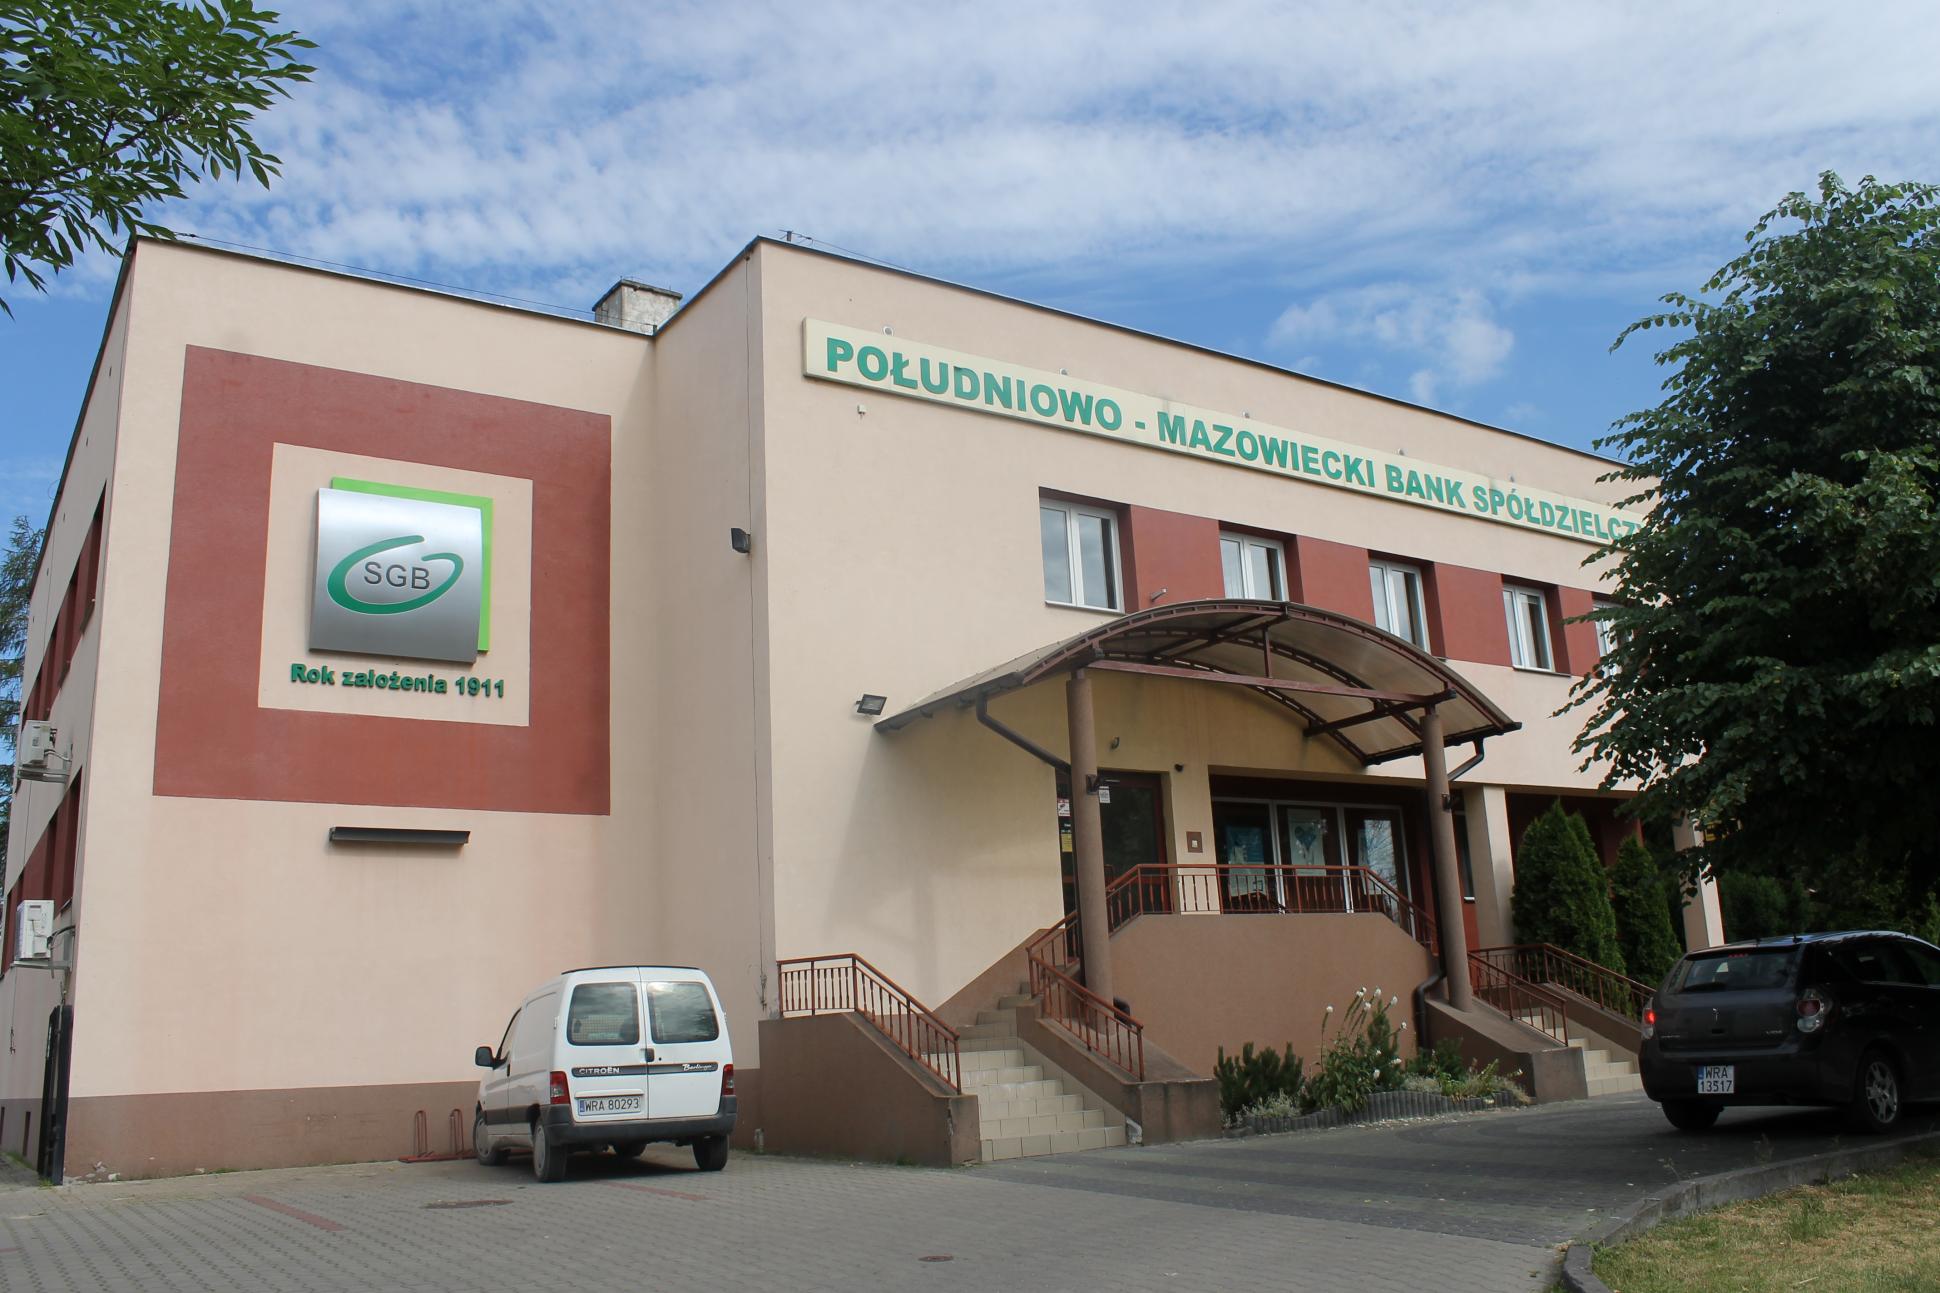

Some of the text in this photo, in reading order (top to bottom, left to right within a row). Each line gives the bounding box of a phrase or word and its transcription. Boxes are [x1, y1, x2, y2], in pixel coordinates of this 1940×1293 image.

[826, 336, 1122, 431] POŁUDNIOWO
[1157, 411, 1376, 488] MAZOWIECKI
[1384, 463, 1466, 509] BANK
[363, 561, 430, 590] SGB
[291, 663, 505, 698] Rok założenia 1911
[579, 1066, 620, 1075] CITROËN
[1705, 1066, 1728, 1079] WRA
[1700, 1080, 1732, 1092] 13517
[585, 1098, 639, 1112] WRA 80293
